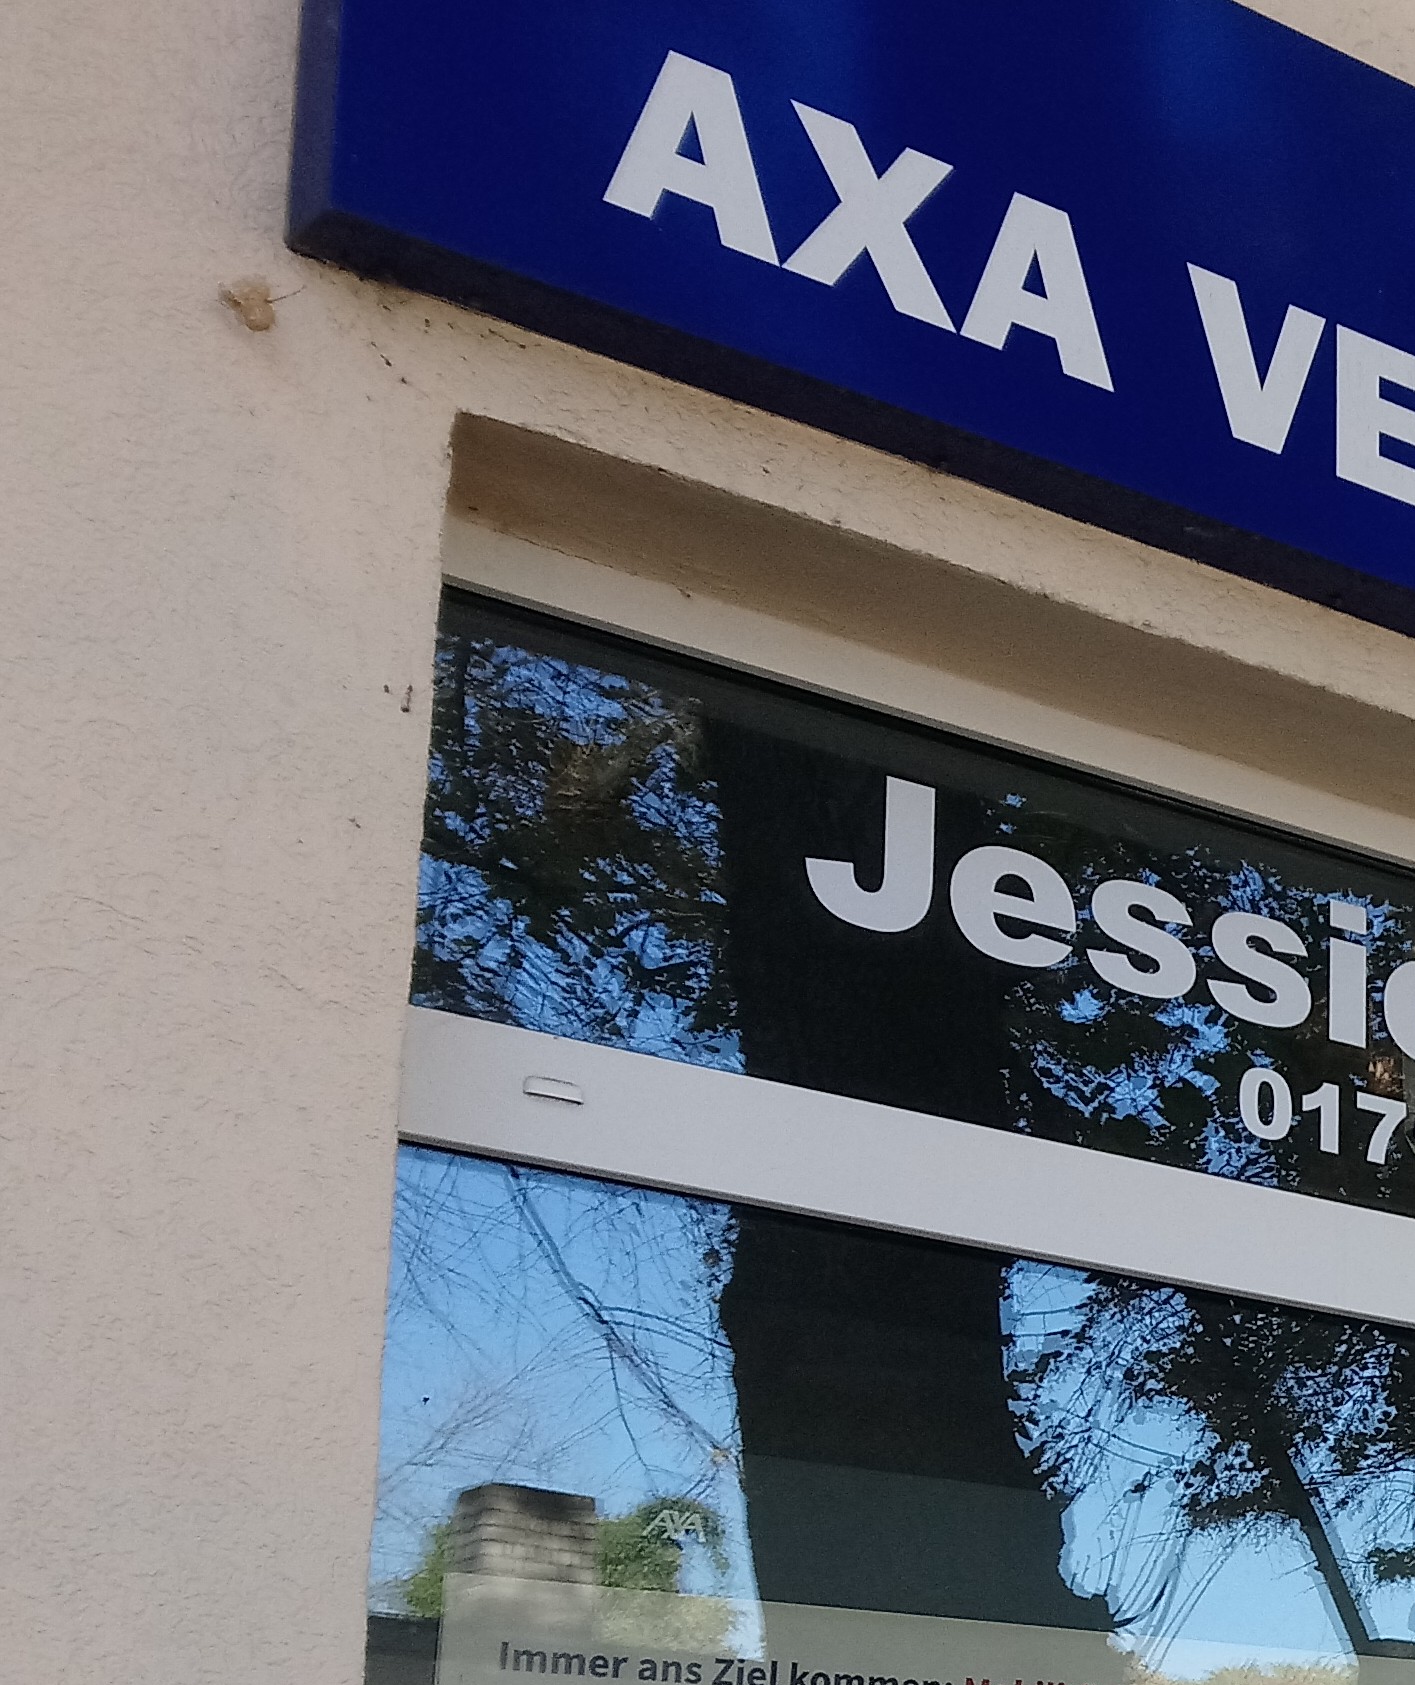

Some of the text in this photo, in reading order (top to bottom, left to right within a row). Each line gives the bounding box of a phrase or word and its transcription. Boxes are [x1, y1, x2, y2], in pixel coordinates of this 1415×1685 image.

[602, 50, 1114, 392] AXA
[501, 1640, 629, 1679] Immer
[638, 1661, 702, 1685] ans
